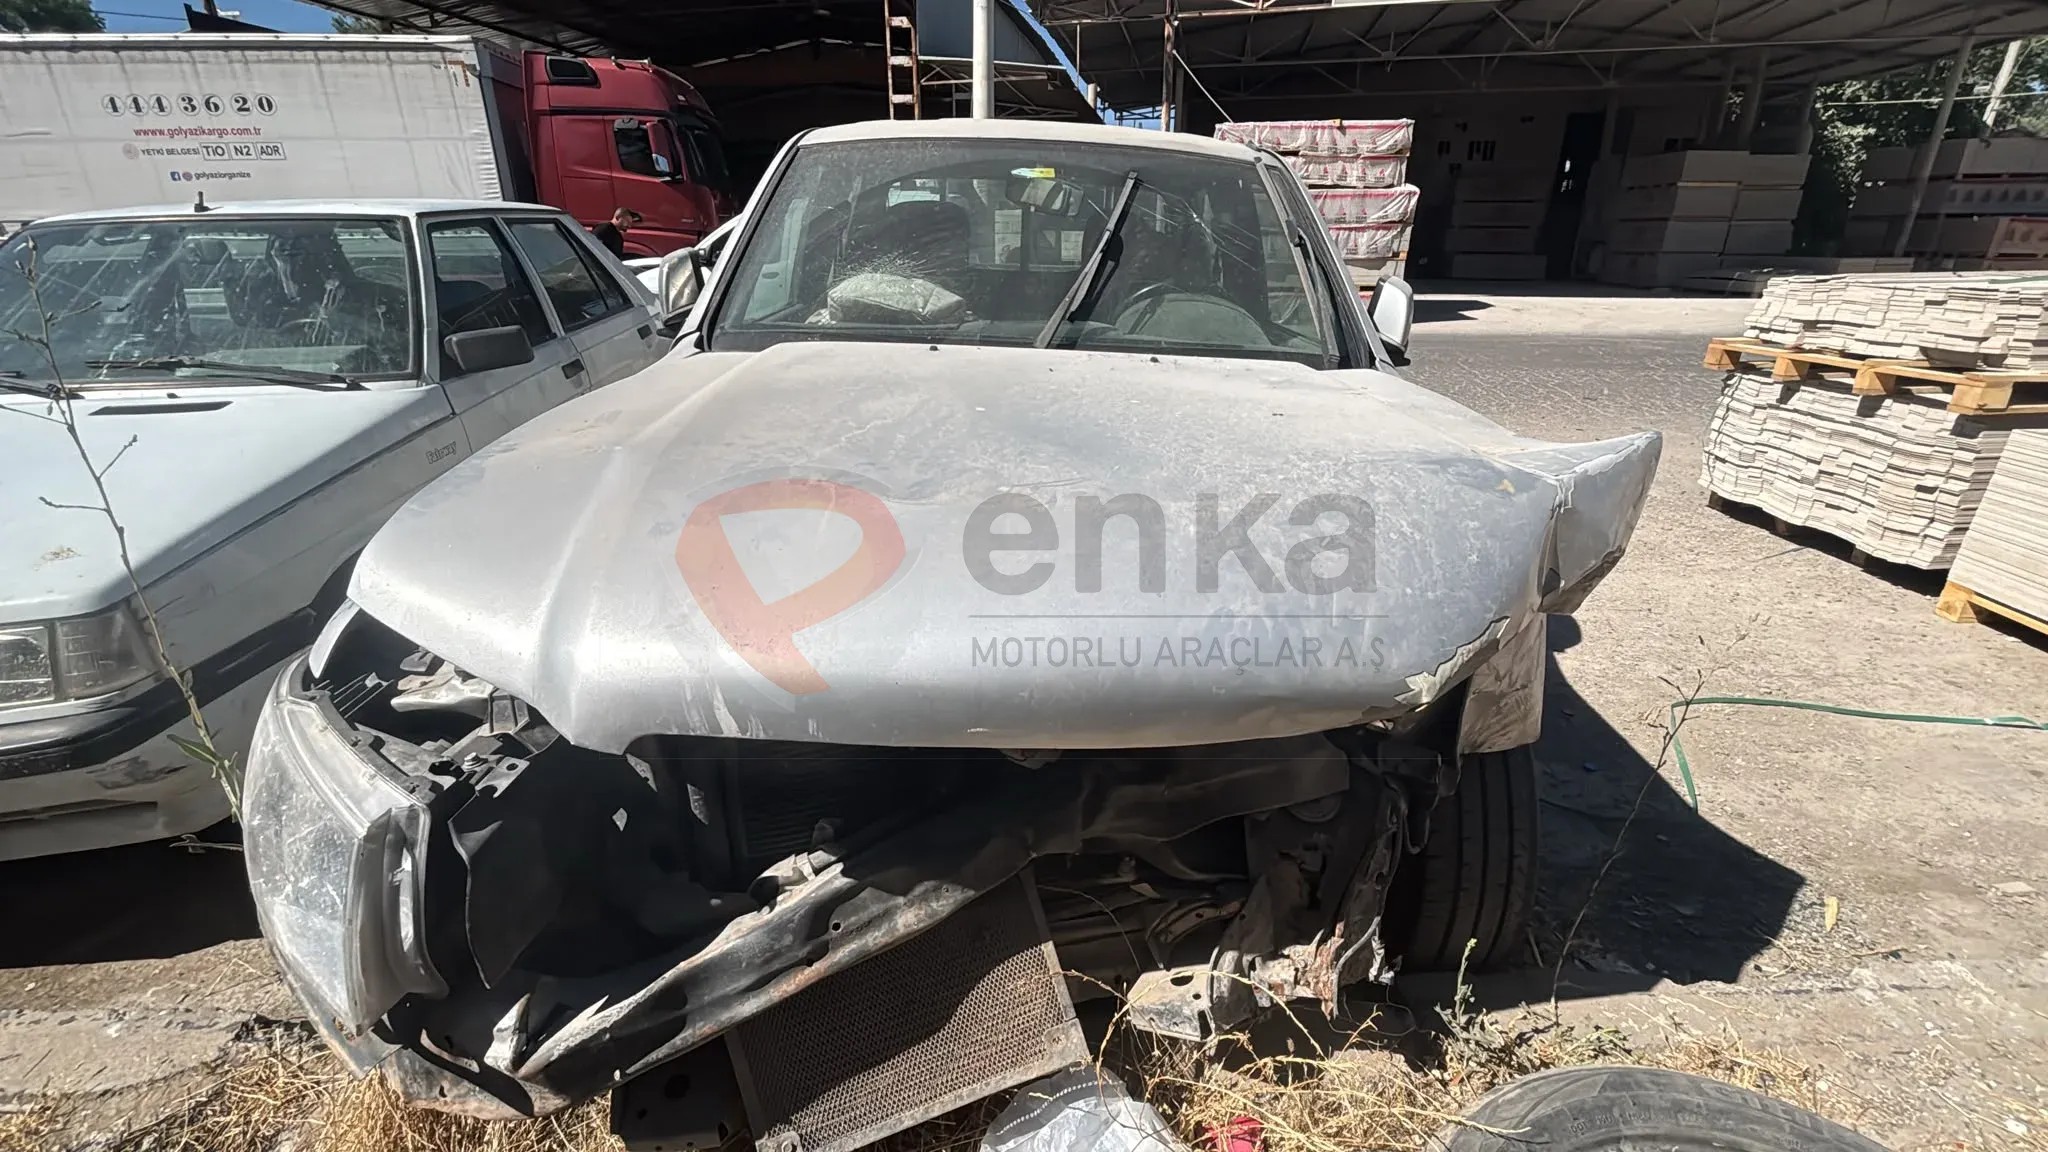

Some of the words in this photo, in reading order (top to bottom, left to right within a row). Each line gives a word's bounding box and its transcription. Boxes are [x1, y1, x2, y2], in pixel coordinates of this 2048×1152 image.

[104, 95, 169, 114] 444
[133, 126, 262, 139] www.golyazikargo.com.tr
[234, 145, 252, 157] N2
[260, 145, 281, 157] ADR
